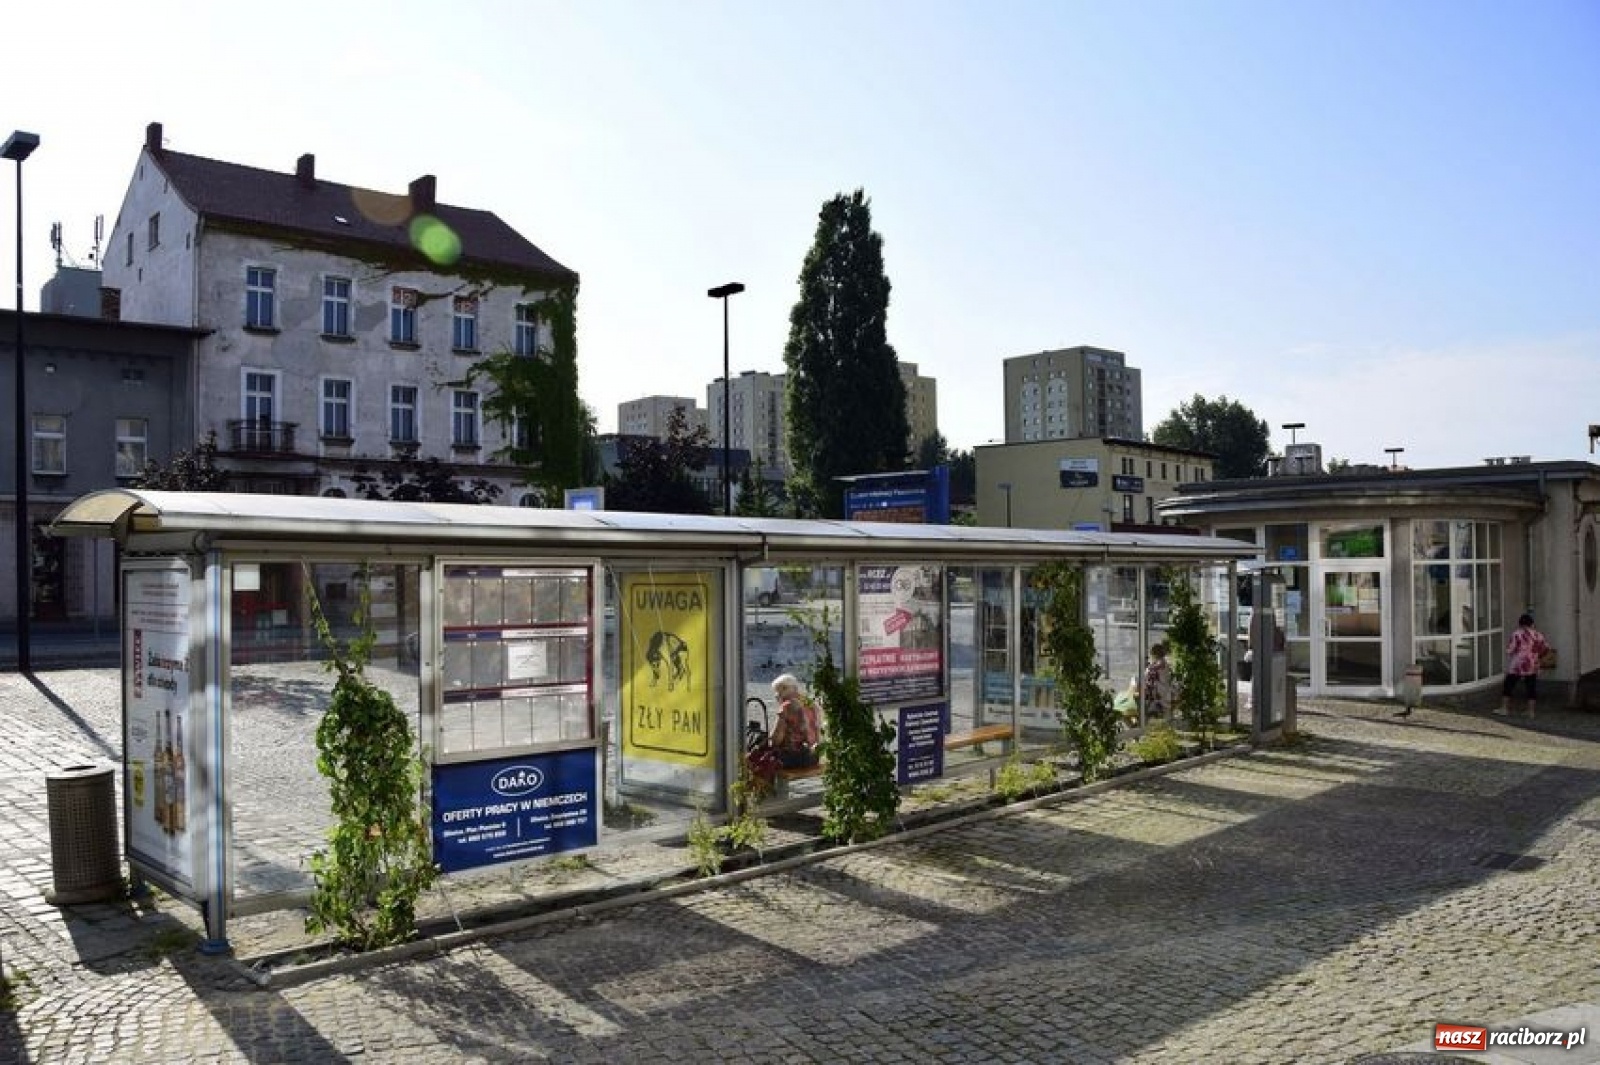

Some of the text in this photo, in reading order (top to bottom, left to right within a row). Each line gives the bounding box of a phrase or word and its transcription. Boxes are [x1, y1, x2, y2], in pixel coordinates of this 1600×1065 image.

[636, 590, 703, 612] UWAGA
[638, 705, 702, 735] ZŁY PAN
[443, 792, 588, 823] OFERTY PRACY W NIEMCZECH
